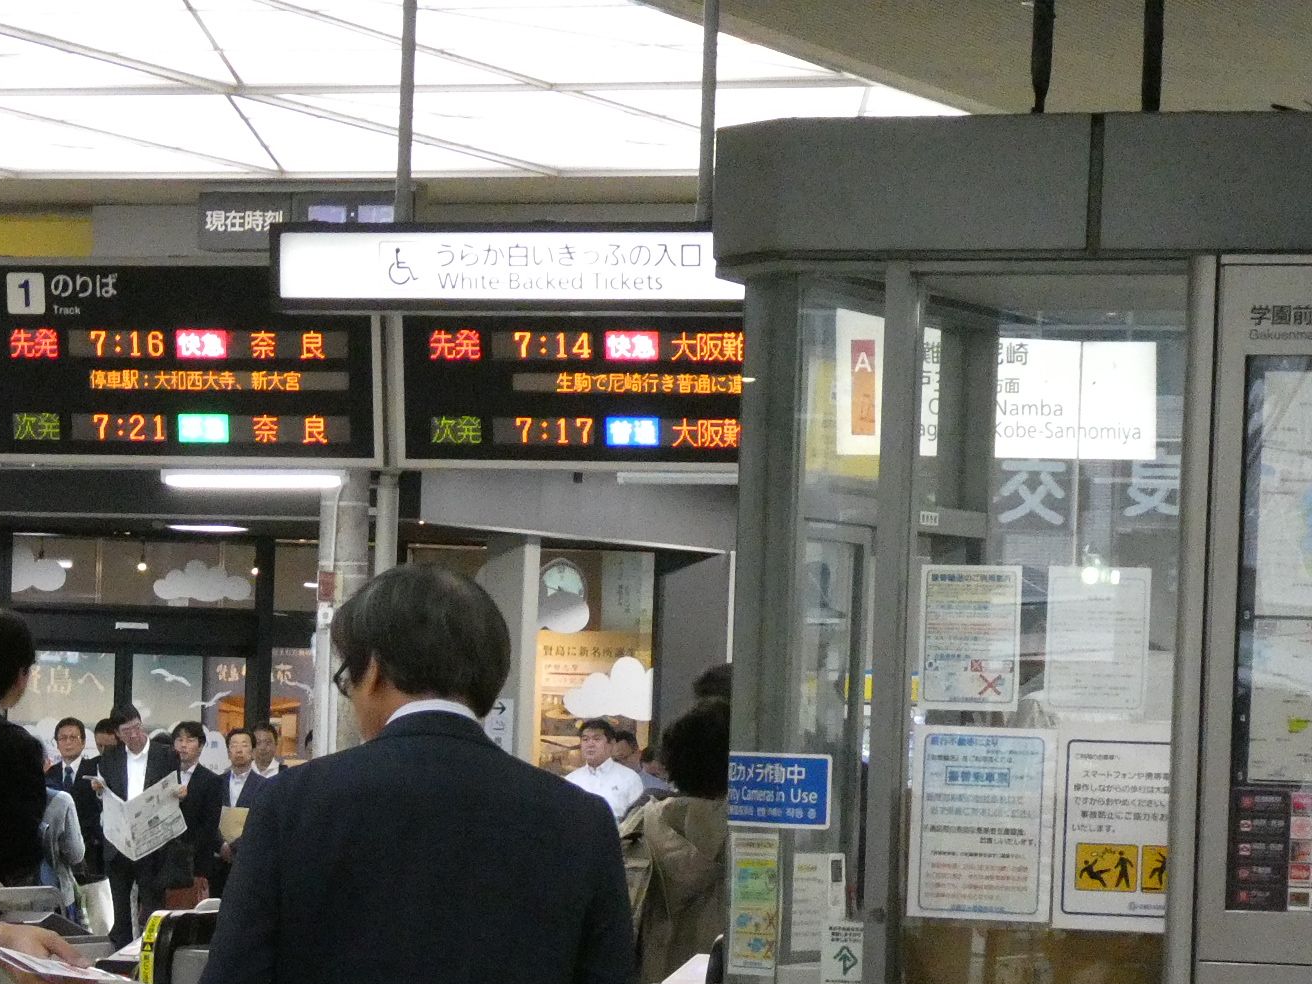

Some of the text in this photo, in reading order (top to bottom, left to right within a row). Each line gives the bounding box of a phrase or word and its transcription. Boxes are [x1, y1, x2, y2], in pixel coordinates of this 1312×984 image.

[205, 210, 283, 232] 現在時刻
[50, 274, 118, 298] のりば
[596, 272, 663, 290] Tickets
[17, 279, 31, 308] 1
[53, 305, 81, 315] Track
[10, 329, 59, 358] 先発
[90, 331, 165, 357] 7:16
[429, 331, 481, 360] 先発
[513, 332, 591, 358] 7:14
[854, 352, 873, 372] A
[14, 415, 61, 440] 次発
[93, 414, 166, 441] 7:21
[431, 416, 482, 444] 次発
[515, 417, 593, 444] 7:17
[609, 421, 656, 443] 普通
[791, 788, 818, 804] Use
